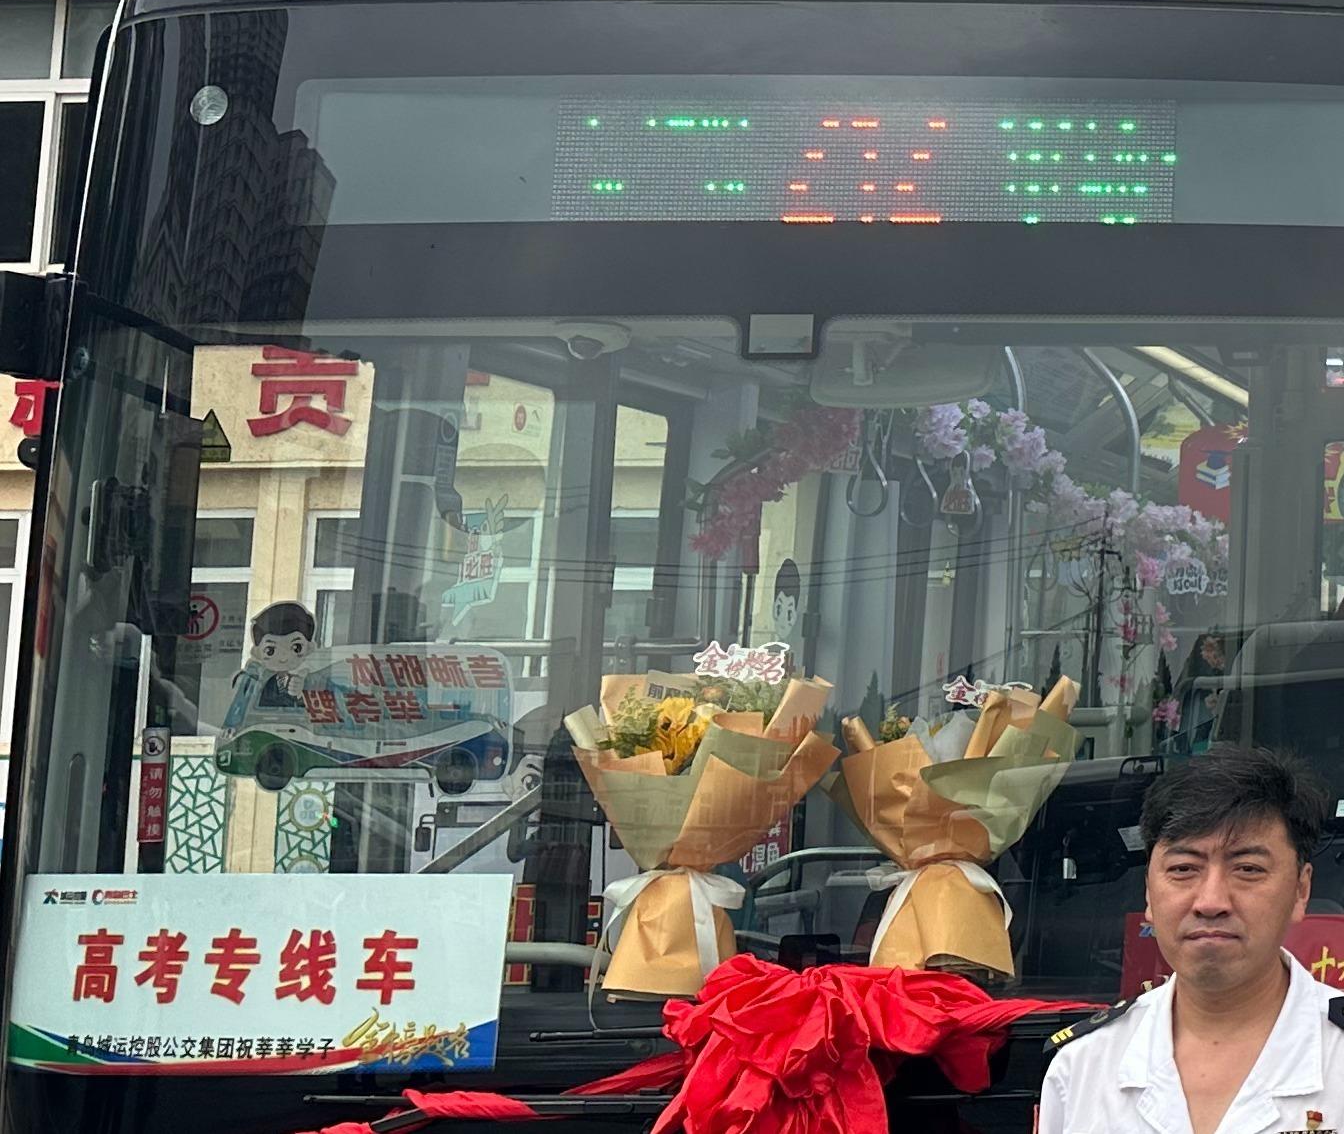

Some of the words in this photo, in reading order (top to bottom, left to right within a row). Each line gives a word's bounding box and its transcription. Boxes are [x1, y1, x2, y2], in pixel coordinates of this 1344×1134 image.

[72, 928, 420, 1006] 高考专线车
